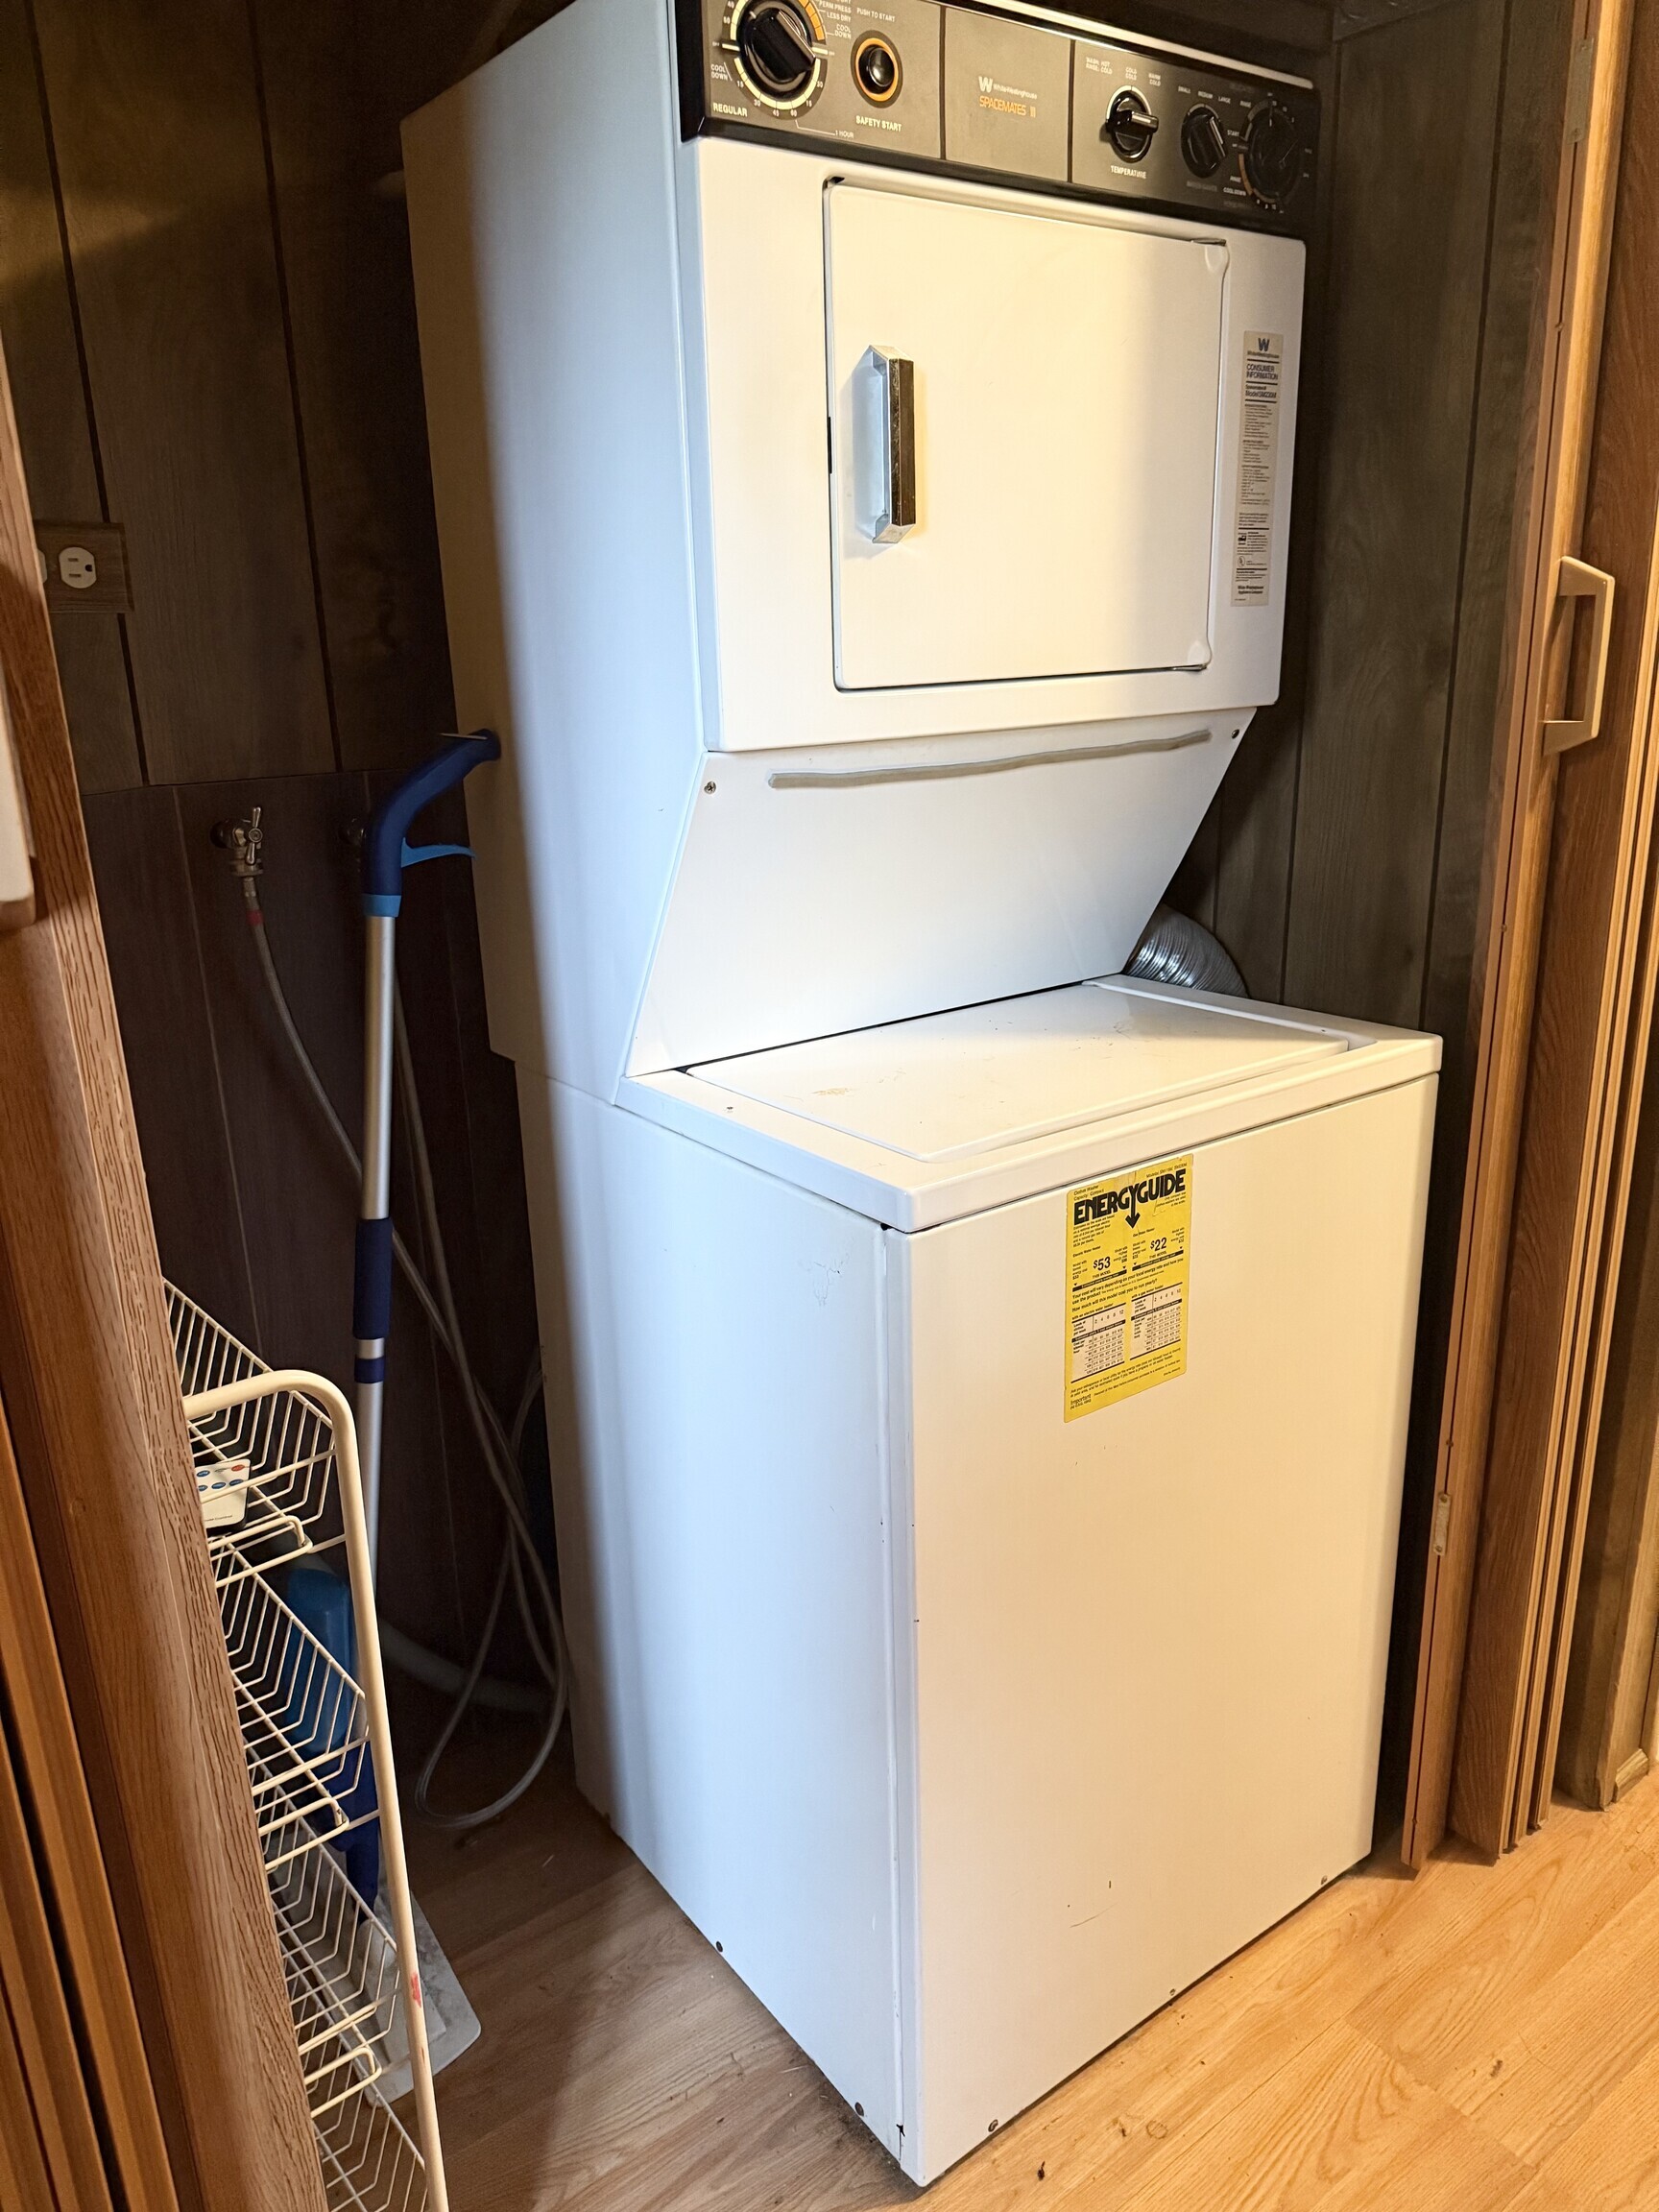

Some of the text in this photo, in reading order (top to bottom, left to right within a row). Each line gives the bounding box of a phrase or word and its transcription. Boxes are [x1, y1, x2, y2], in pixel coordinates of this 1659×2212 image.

[834, 5, 852, 13] PRESS
[856, 8, 870, 16] PUSH
[878, 12, 896, 22] START
[836, 24, 852, 33] COOL
[834, 31, 852, 39] DOWN
[711, 63, 726, 73] COOL
[1101, 65, 1113, 75] COLD
[711, 71, 728, 81] DOWN
[754, 99, 760, 108] 30
[979, 96, 1027, 116] SPACEMATES
[713, 102, 748, 117] REGULAR
[855, 115, 902, 132] SAFETY START
[839, 131, 854, 139] HOUR
[1111, 165, 1146, 180] TEMPERATURE
[1258, 337, 1270, 352] W
[1246, 364, 1275, 373] CONSUMER
[1246, 371, 1279, 380] INFORMATION
[1074, 1168, 1186, 1226] ENERGYGUIDE
[1150, 1237, 1167, 1252] $22
[1093, 1256, 1111, 1271] $53
